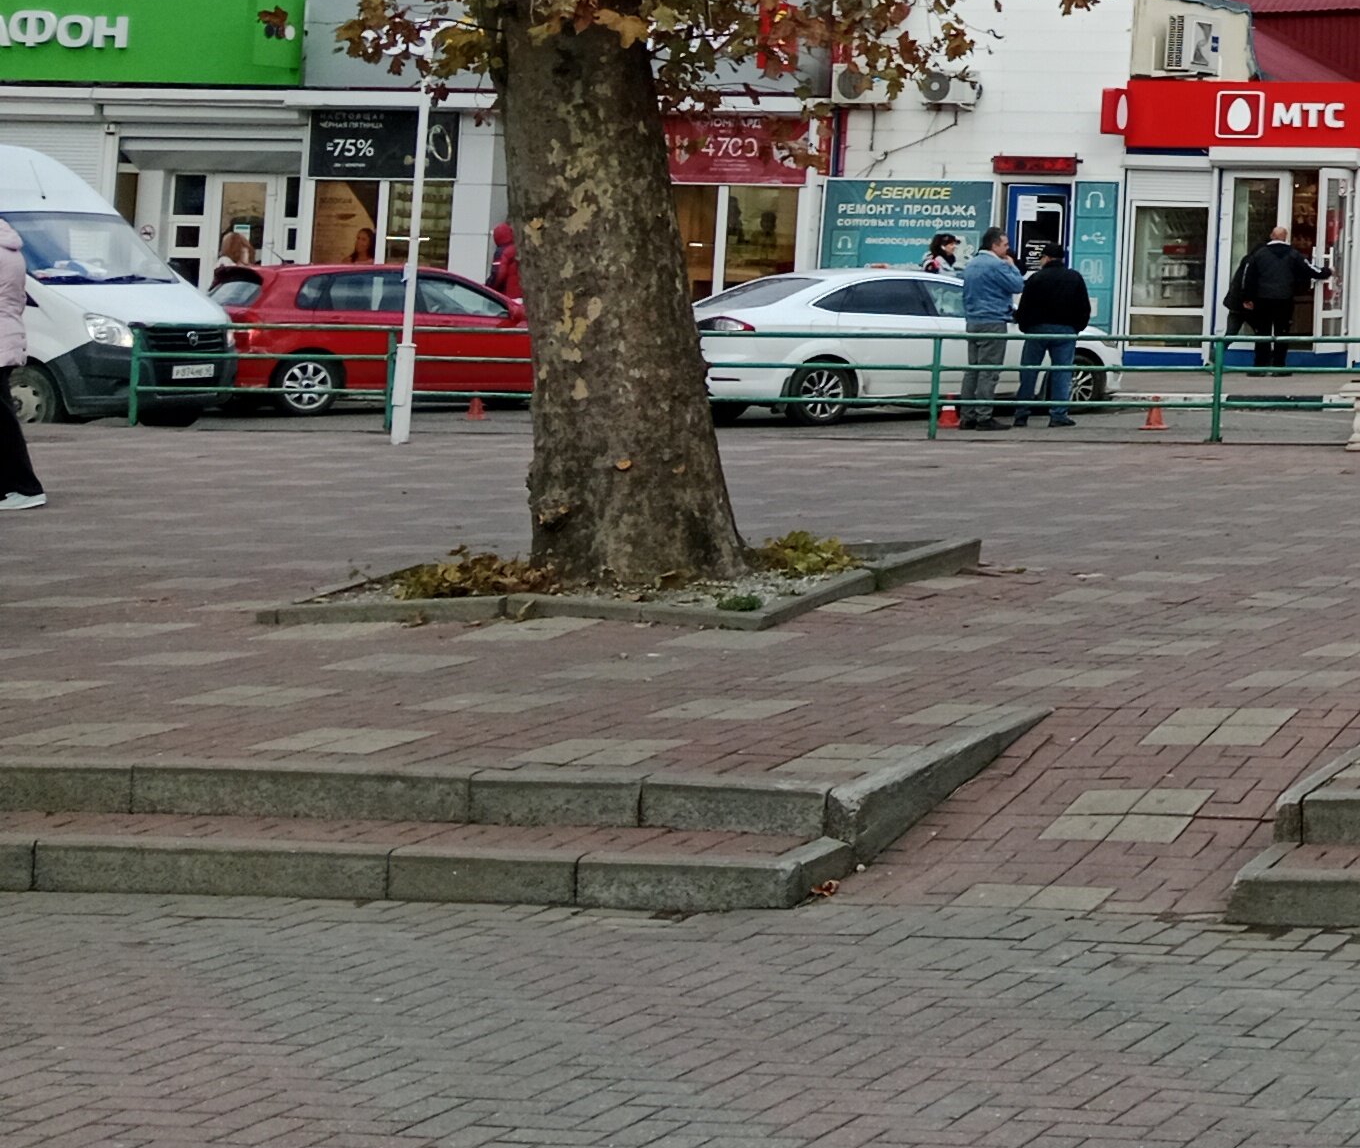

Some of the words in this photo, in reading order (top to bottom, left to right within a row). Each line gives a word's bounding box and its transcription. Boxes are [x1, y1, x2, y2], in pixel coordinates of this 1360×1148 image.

[1272, 102, 1345, 128] МТС
[865, 182, 952, 202] i-SERVICE
[838, 204, 895, 216] РЕМОНТ
[904, 205, 976, 218] ПРОДАЖА
[898, 217, 976, 229] телефонов
